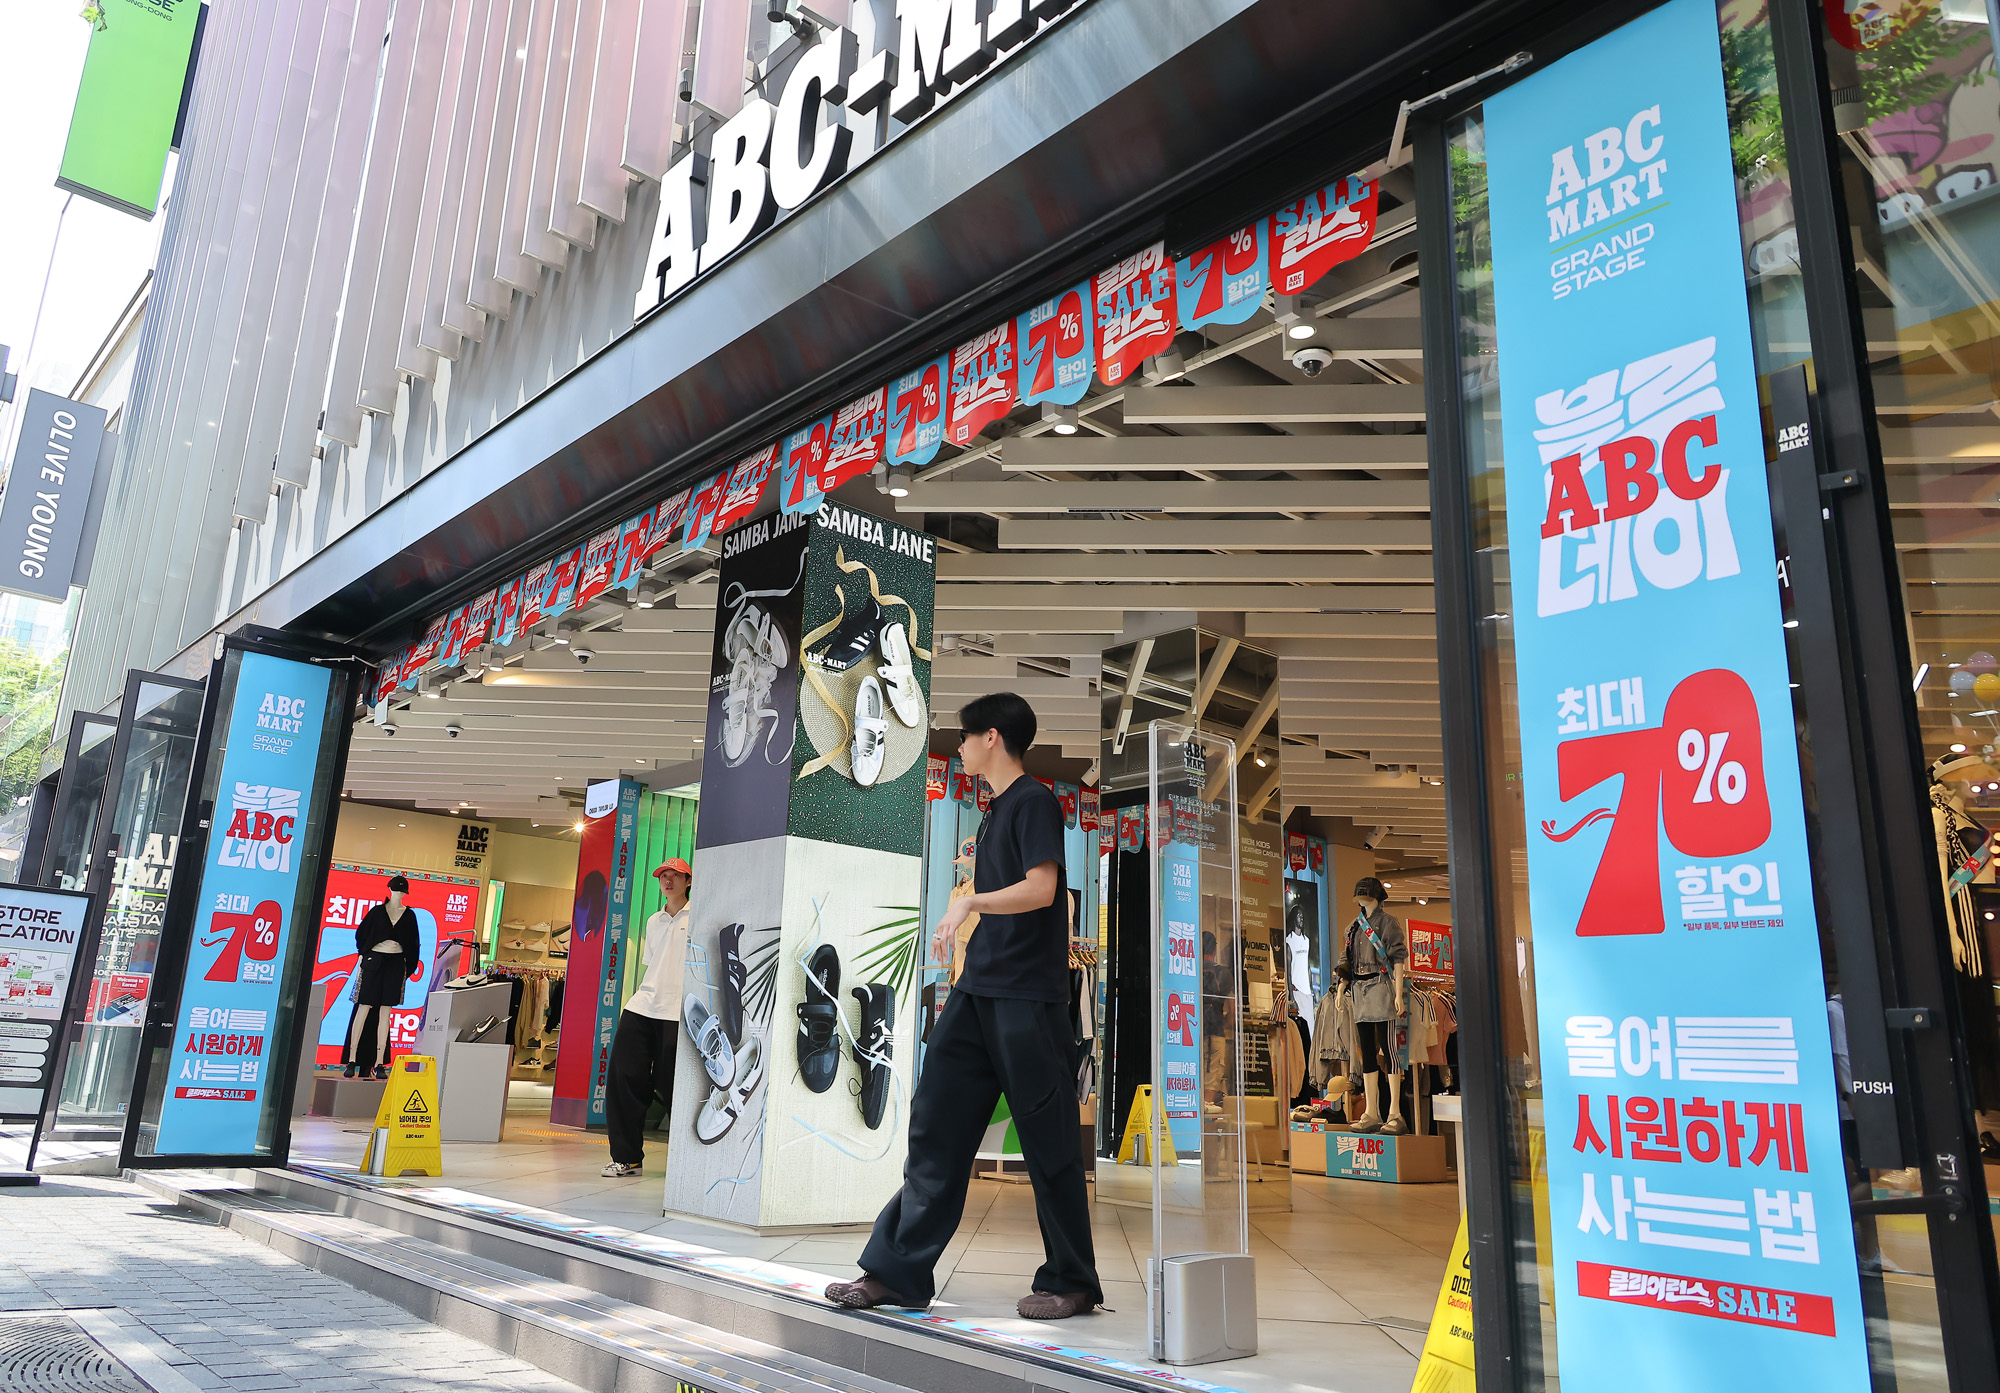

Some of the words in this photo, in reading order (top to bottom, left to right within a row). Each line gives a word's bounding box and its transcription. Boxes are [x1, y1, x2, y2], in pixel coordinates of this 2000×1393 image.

[634, 0, 1045, 325] ABC-M
[1545, 104, 1664, 206] ABC
[1275, 176, 1371, 237] SALE
[1547, 158, 1667, 243] MART
[1551, 222, 1655, 279] GRAND
[1552, 247, 1646, 300] STAGE
[1097, 268, 1171, 328] SALE
[1227, 271, 1260, 303] 할인
[1029, 300, 1053, 327] 최대
[1028, 291, 1085, 396] 70%
[951, 342, 1012, 394] SALE
[1057, 358, 1087, 385] 할인
[898, 371, 919, 394] 최대
[895, 364, 940, 458] 70%
[790, 429, 808, 450] 최대
[829, 409, 885, 450] SALE
[918, 423, 940, 447] 할인
[1778, 422, 1809, 443] ABC
[40, 410, 77, 486] OLIVE
[1779, 437, 1810, 453] MART
[786, 423, 826, 507] 70%
[1541, 414, 1721, 539] ABC
[698, 476, 714, 493] 최대
[726, 461, 772, 495] SALE
[686, 471, 729, 544] 70%
[19, 491, 61, 579] YOUNG
[624, 517, 639, 533] 최대
[816, 502, 885, 547] SAMBA
[889, 528, 933, 564] JANE
[723, 518, 769, 559] SAMBA
[1537, 468, 1741, 617] 데이
[558, 550, 572, 565] 최대
[584, 542, 617, 573] SALE
[544, 547, 582, 608] 70%
[469, 603, 494, 627] SALE
[806, 651, 848, 670] ABC-MART
[259, 692, 305, 719] ABC
[1557, 676, 1646, 735] 최대
[256, 713, 303, 734] MART
[252, 742, 288, 755] STAGE
[253, 734, 293, 747] GRAND
[623, 788, 637, 796] ABC
[1557, 668, 1772, 937] 70%
[226, 808, 295, 844] ABC
[458, 825, 489, 842] ABC
[217, 832, 294, 874] 데이
[457, 840, 487, 854] MART
[1256, 841, 1270, 849] KIDS
[1263, 850, 1281, 859] CASUAL
[455, 855, 482, 864] GRAND
[455, 861, 479, 869] STAGE
[618, 842, 628, 878] ABC
[1242, 867, 1265, 875] APPAREL
[214, 892, 250, 912] 최대
[446, 894, 468, 906] ABC
[613, 877, 627, 903] 데이
[1243, 897, 1258, 905] MEN
[1675, 862, 1783, 920] 할인
[128, 913, 163, 926] STA
[446, 903, 468, 912] MART
[1243, 910, 1267, 918] FOOTWEAR
[1243, 919, 1264, 927] APPAREL
[1724, 921, 1739, 929] 일부
[1741, 919, 1765, 928] 브랜드
[1767, 918, 1784, 927] 제외
[203, 900, 282, 983] 70%
[1245, 941, 1270, 951] WOMEN
[1412, 929, 1432, 944] 클리어
[1412, 941, 1432, 956] SALE
[242, 961, 275, 981] 할인
[608, 943, 618, 980] ABC
[603, 979, 617, 1007] 데이
[188, 1006, 267, 1031] 올여름
[184, 1033, 264, 1056] 시원하게
[1564, 1015, 1799, 1085] 올여름
[598, 1047, 608, 1087] ABC
[223, 1090, 247, 1099] SALE
[593, 1085, 606, 1113] 데이
[1853, 1081, 1893, 1094] PUSH
[419, 1115, 432, 1123] 주의
[1573, 1094, 1809, 1173] 시원하게
[1357, 1138, 1384, 1155] ABC
[1352, 1153, 1378, 1170] 데이
[1448, 1295, 1468, 1311] Caution!
[1608, 1269, 1715, 1307] 클리어런스
[1717, 1286, 1798, 1324] SALE
